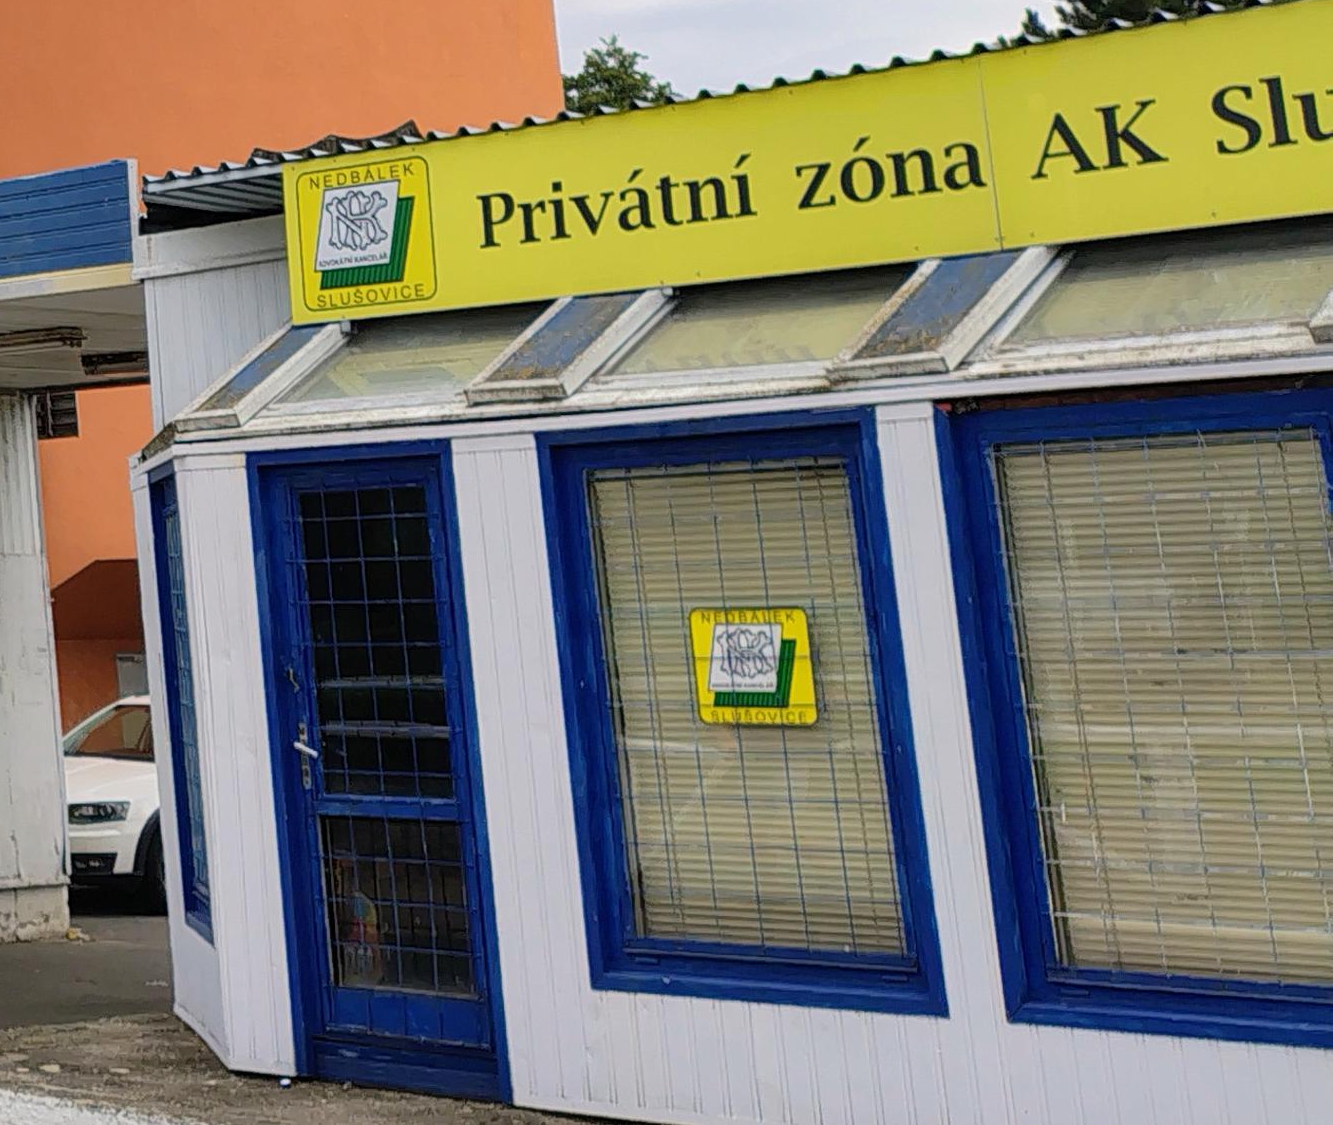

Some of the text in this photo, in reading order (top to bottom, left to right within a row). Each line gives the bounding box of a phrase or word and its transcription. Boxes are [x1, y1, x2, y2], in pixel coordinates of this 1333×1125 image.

[309, 162, 414, 190] NEDBÁLEK
[476, 153, 758, 249] Privátní
[795, 136, 989, 210] zóna
[1030, 98, 1170, 180] AK
[317, 283, 425, 308] SLUŠOVICE
